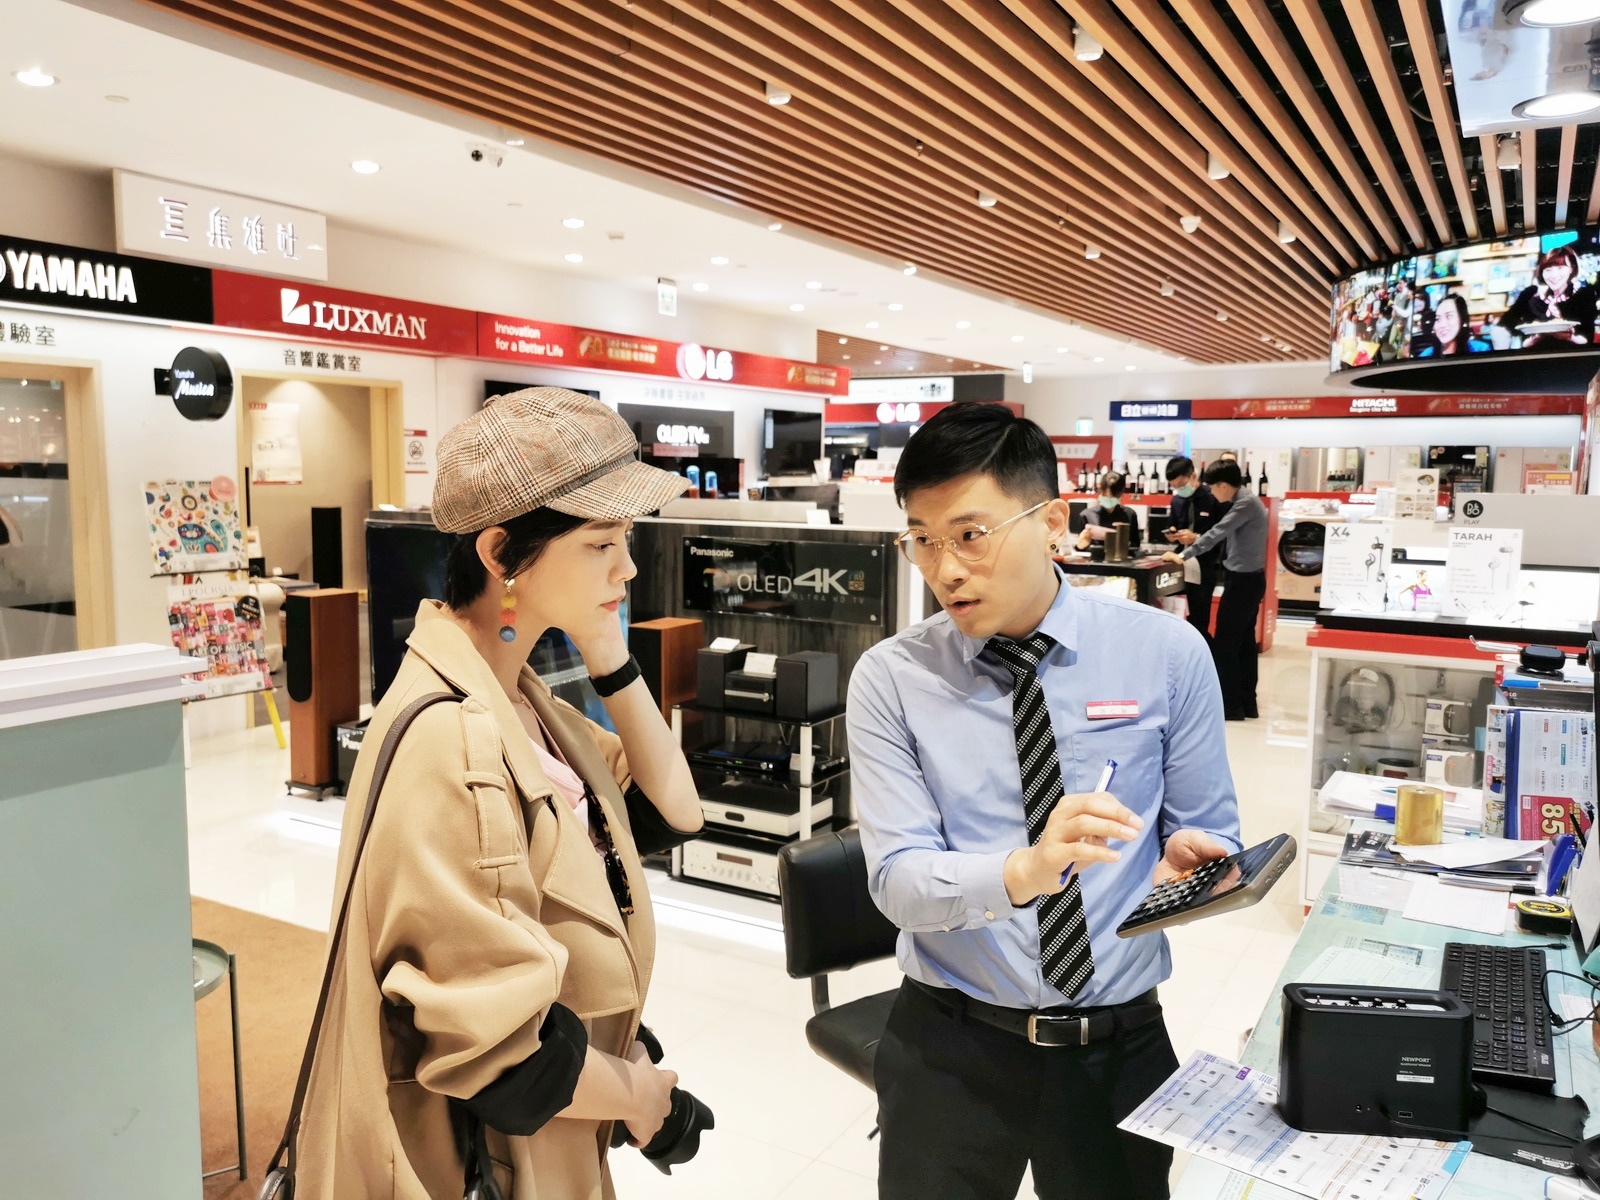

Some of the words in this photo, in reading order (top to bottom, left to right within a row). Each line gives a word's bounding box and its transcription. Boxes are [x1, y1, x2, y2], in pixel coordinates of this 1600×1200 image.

[6, 247, 138, 304] YAMAHA
[311, 301, 428, 341] LUXMAN
[494, 321, 541, 339] Innovation
[495, 337, 509, 350] for
[510, 342, 518, 353] a
[518, 340, 546, 356] Better
[546, 344, 564, 358] Life
[283, 349, 362, 373] 音響鑑賞室
[706, 349, 734, 381] LG
[1352, 398, 1397, 408] HITACHI
[1330, 526, 1351, 537] X4
[1453, 532, 1493, 541] TARAH
[690, 546, 735, 558] Panasonic
[736, 573, 793, 595] OLED
[793, 567, 850, 596] 4K
[191, 646, 209, 658] ART
[210, 644, 224, 656] OF
[225, 641, 253, 654] MUSIC
[1541, 802, 1566, 835] 85
